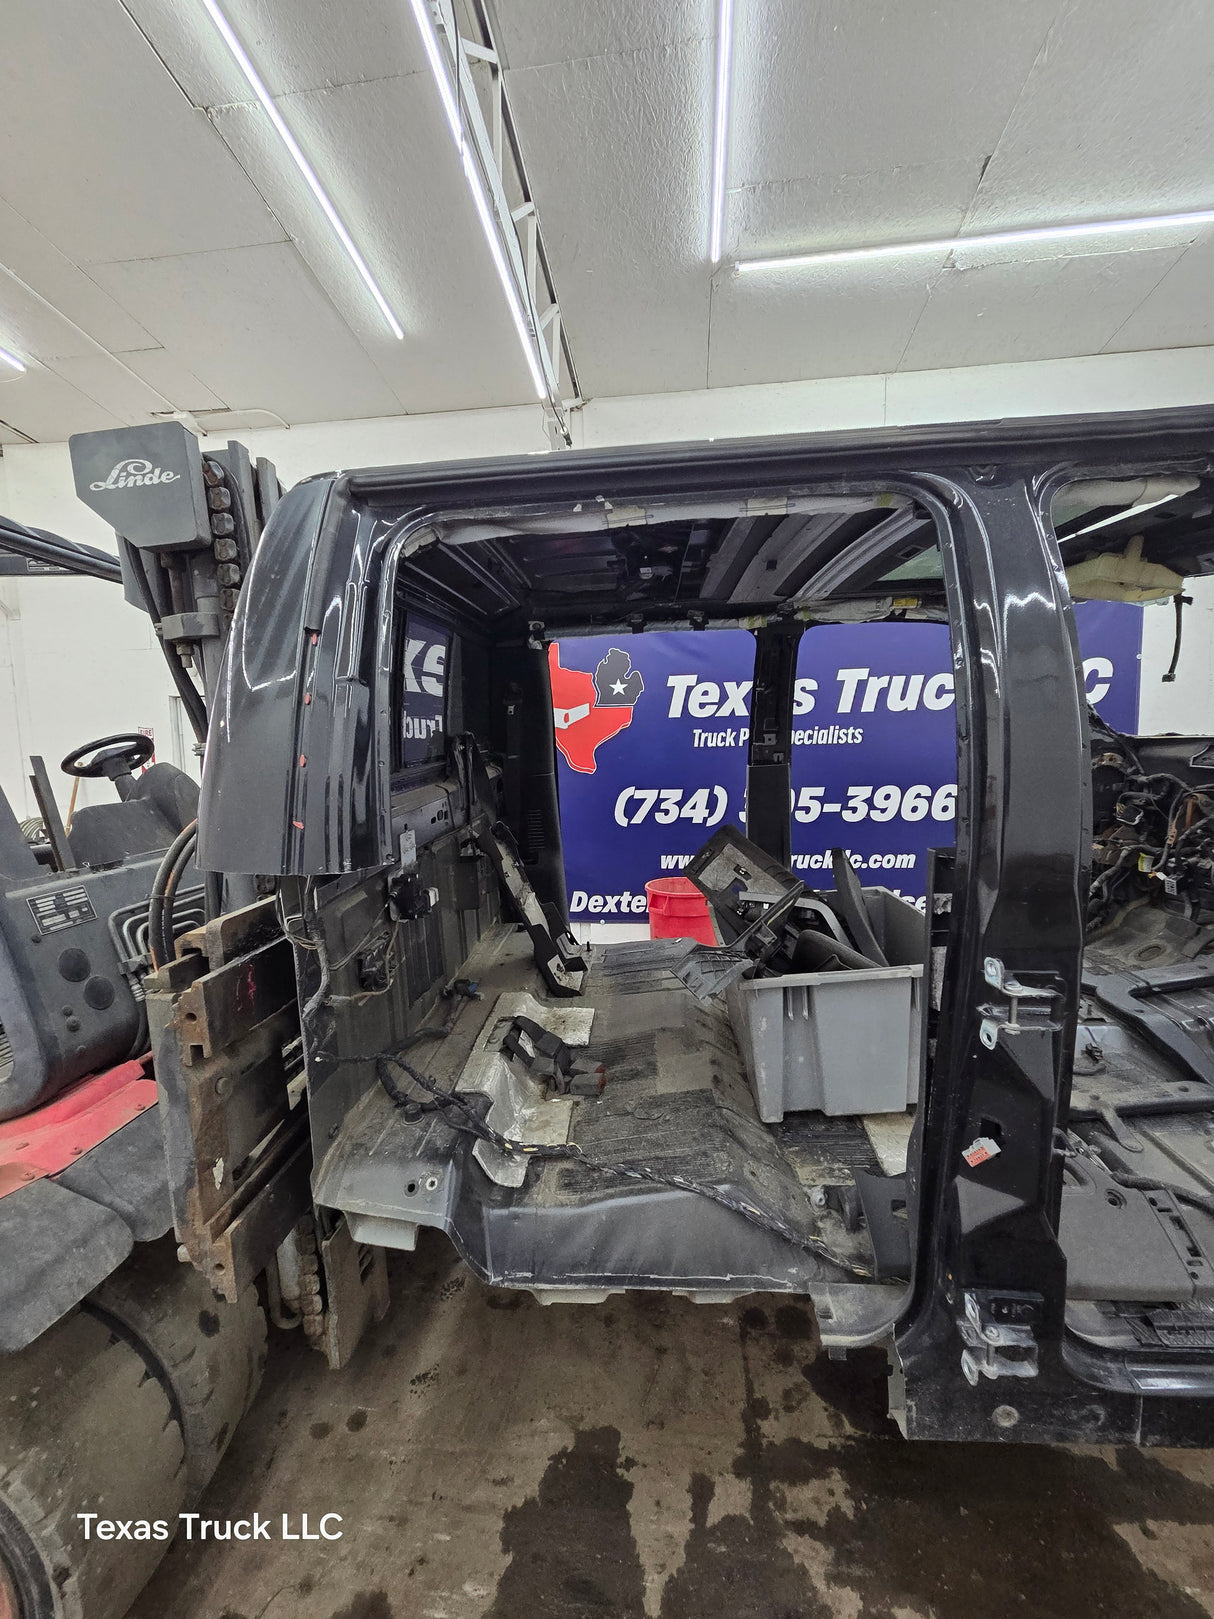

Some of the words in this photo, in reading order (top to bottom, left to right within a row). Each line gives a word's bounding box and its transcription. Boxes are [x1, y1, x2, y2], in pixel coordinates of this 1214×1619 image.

[89, 459, 181, 491] Linde
[666, 674, 818, 718] Texs
[836, 667, 955, 714] Truc
[693, 728, 737, 748] Truck
[790, 725, 864, 746] ecialists
[614, 784, 728, 827] (734)
[738, 784, 958, 823] 5-3966
[569, 890, 649, 914] Dexte
